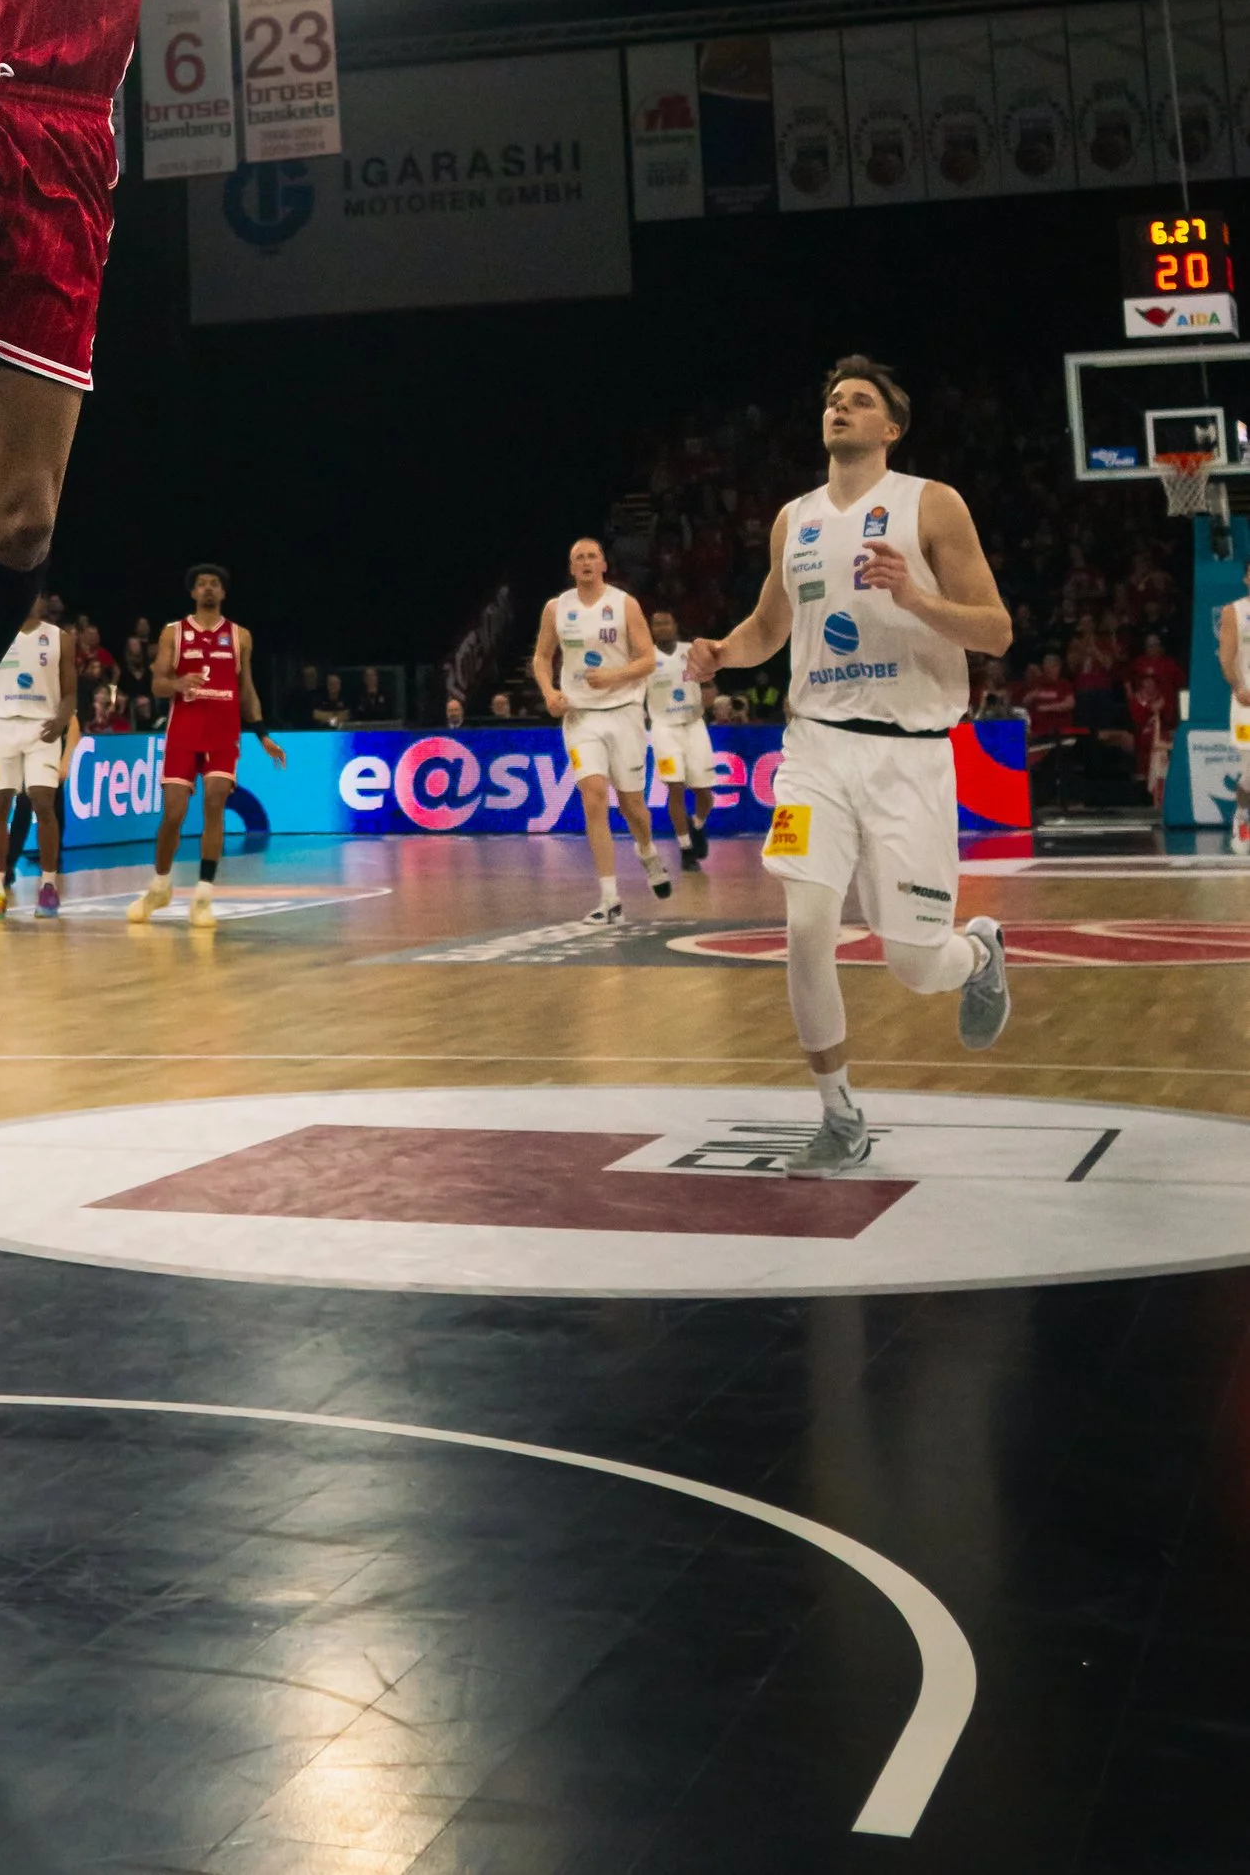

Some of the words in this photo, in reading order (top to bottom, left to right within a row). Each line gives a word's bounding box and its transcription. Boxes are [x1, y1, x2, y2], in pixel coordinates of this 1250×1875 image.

[244, 9, 332, 80] 23
[164, 31, 207, 95] 6
[246, 80, 333, 106] brose
[144, 97, 231, 124] brose
[247, 100, 336, 125] baskets
[145, 121, 232, 142] bamberg
[342, 140, 583, 191] IGARASHI
[343, 192, 487, 219] MOTOREN
[495, 181, 583, 207] GMBH
[1156, 252, 1210, 291] 20
[1176, 310, 1221, 327] AIDA
[598, 627, 617, 644] 40
[39, 652, 48, 667] 5
[772, 832, 798, 844] OTTO
